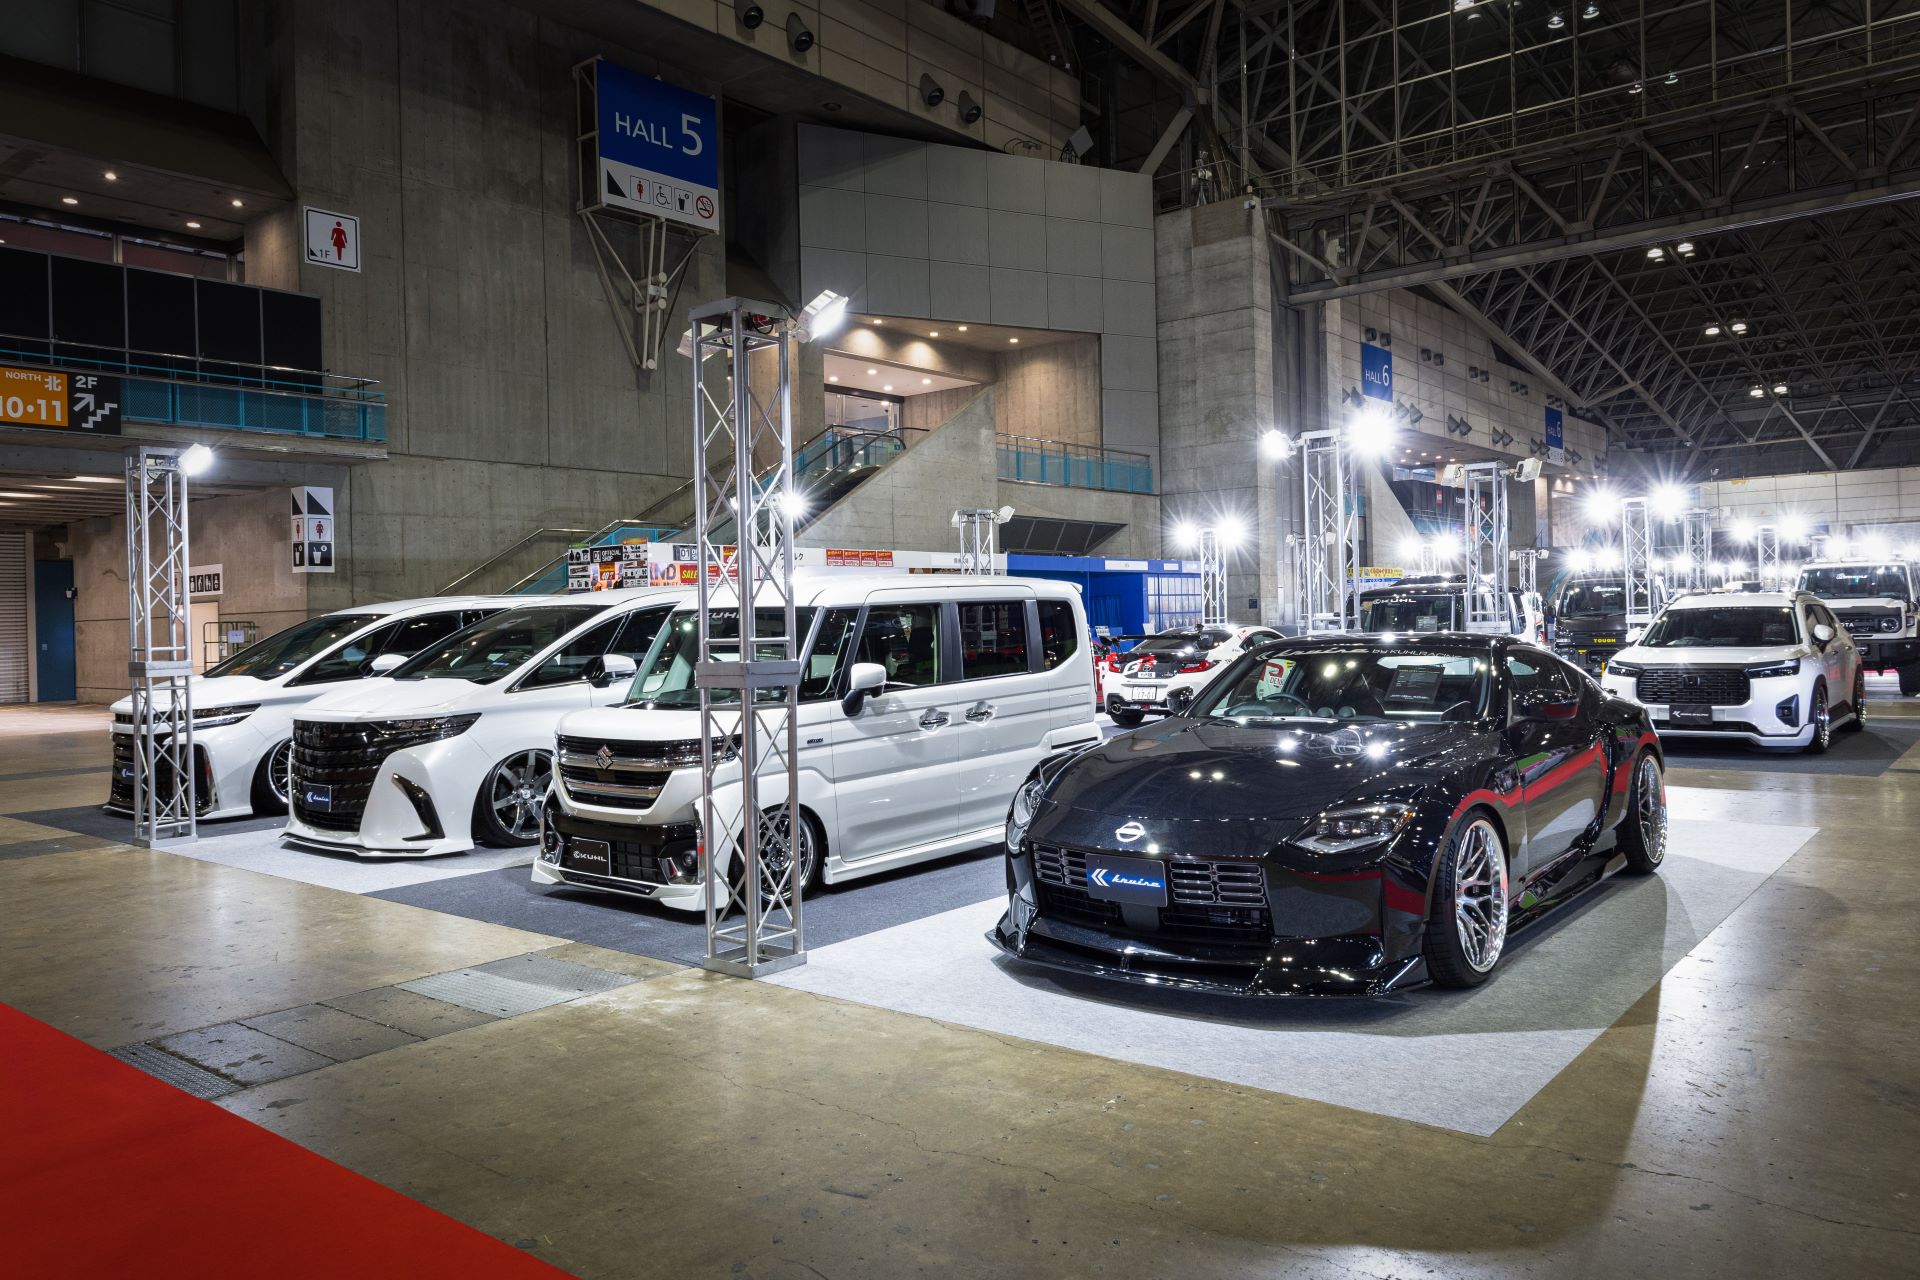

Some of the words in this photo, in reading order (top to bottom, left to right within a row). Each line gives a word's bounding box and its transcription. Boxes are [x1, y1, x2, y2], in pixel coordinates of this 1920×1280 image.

[615, 111, 673, 149] HALL
[681, 113, 703, 156] 5
[319, 248, 331, 259] 1F
[5, 371, 42, 382] NORTH
[75, 375, 98, 389] 2F
[1365, 369, 1382, 384] HALL
[1382, 364, 1390, 387] 6
[44, 375, 62, 391] 北
[580, 852, 607, 862] KUHL
